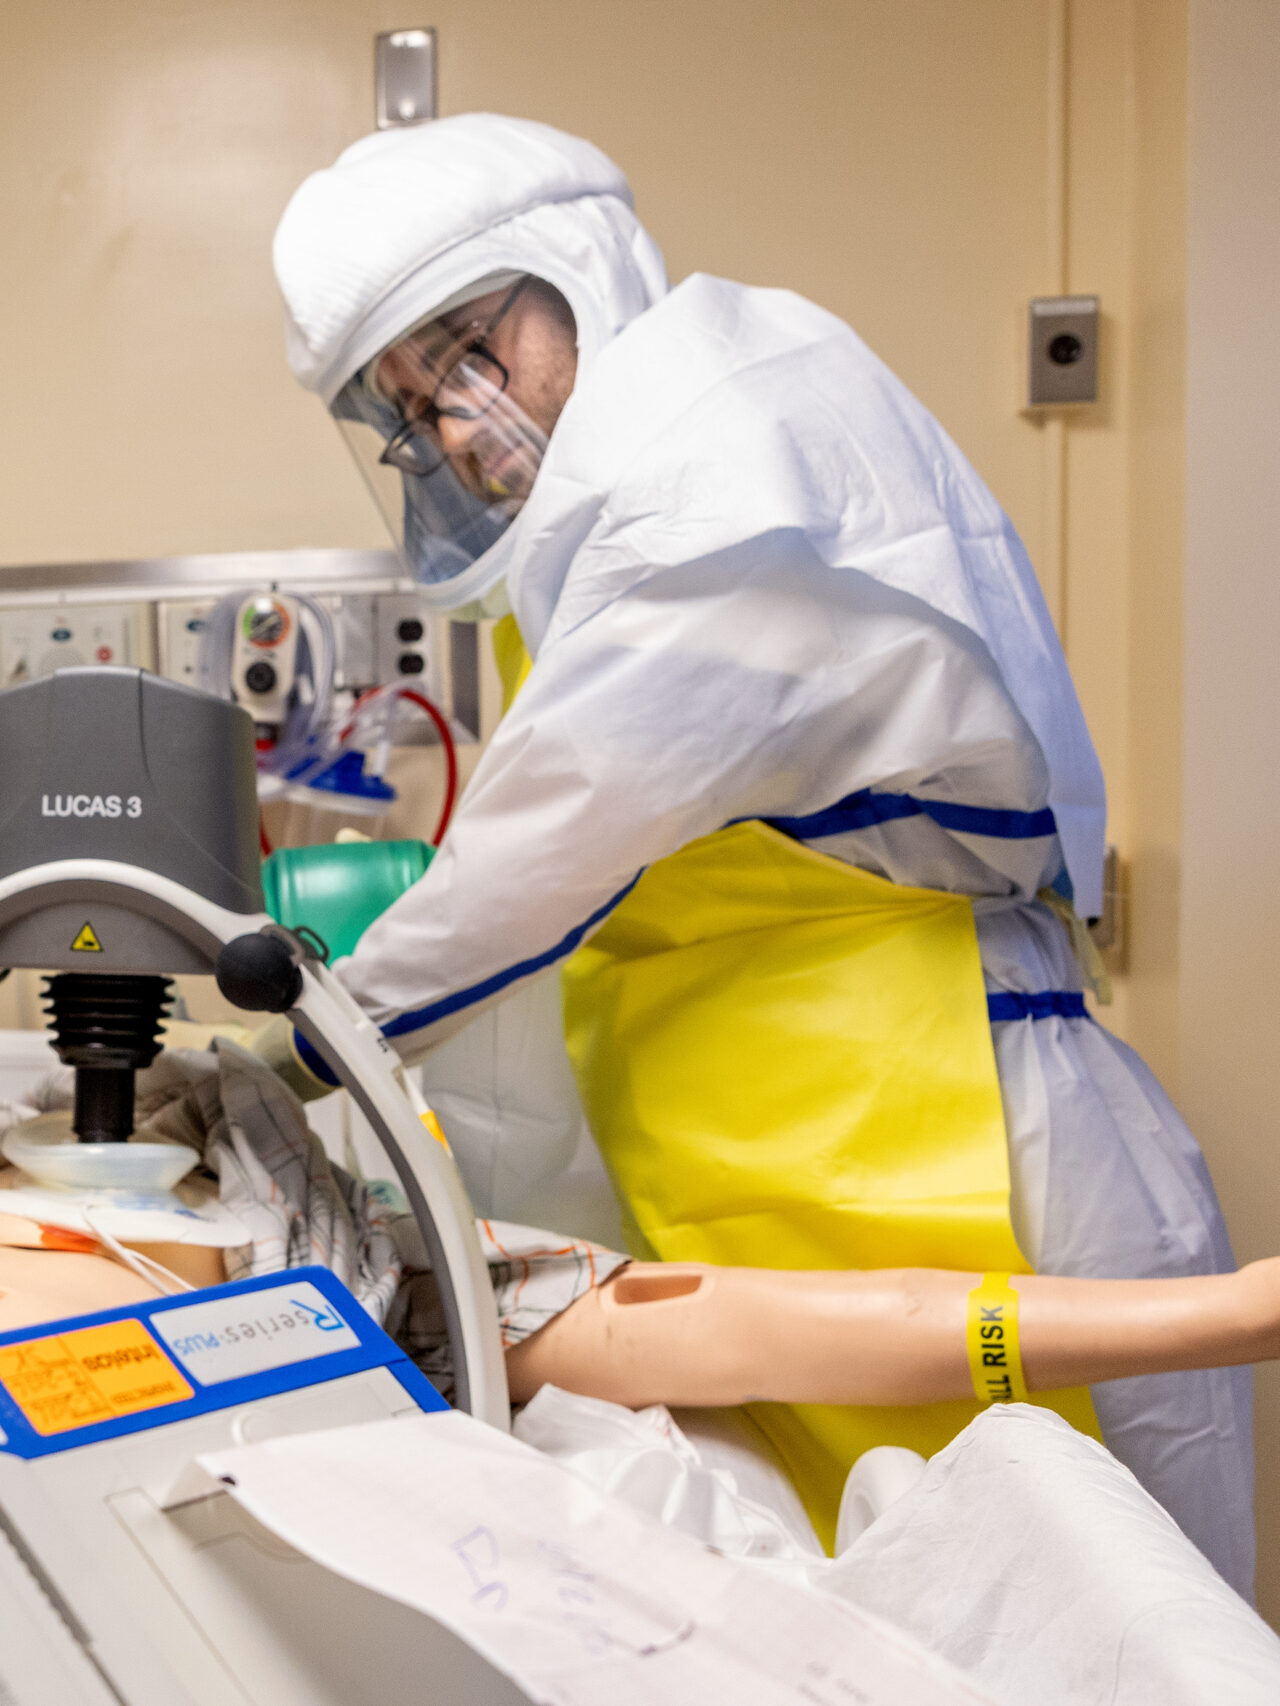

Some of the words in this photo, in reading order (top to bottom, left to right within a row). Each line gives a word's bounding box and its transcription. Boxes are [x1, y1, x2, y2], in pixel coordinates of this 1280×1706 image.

[41, 794, 122, 818] LUCAS
[126, 795, 143, 818] 3
[980, 1305, 1007, 1366] RISK
